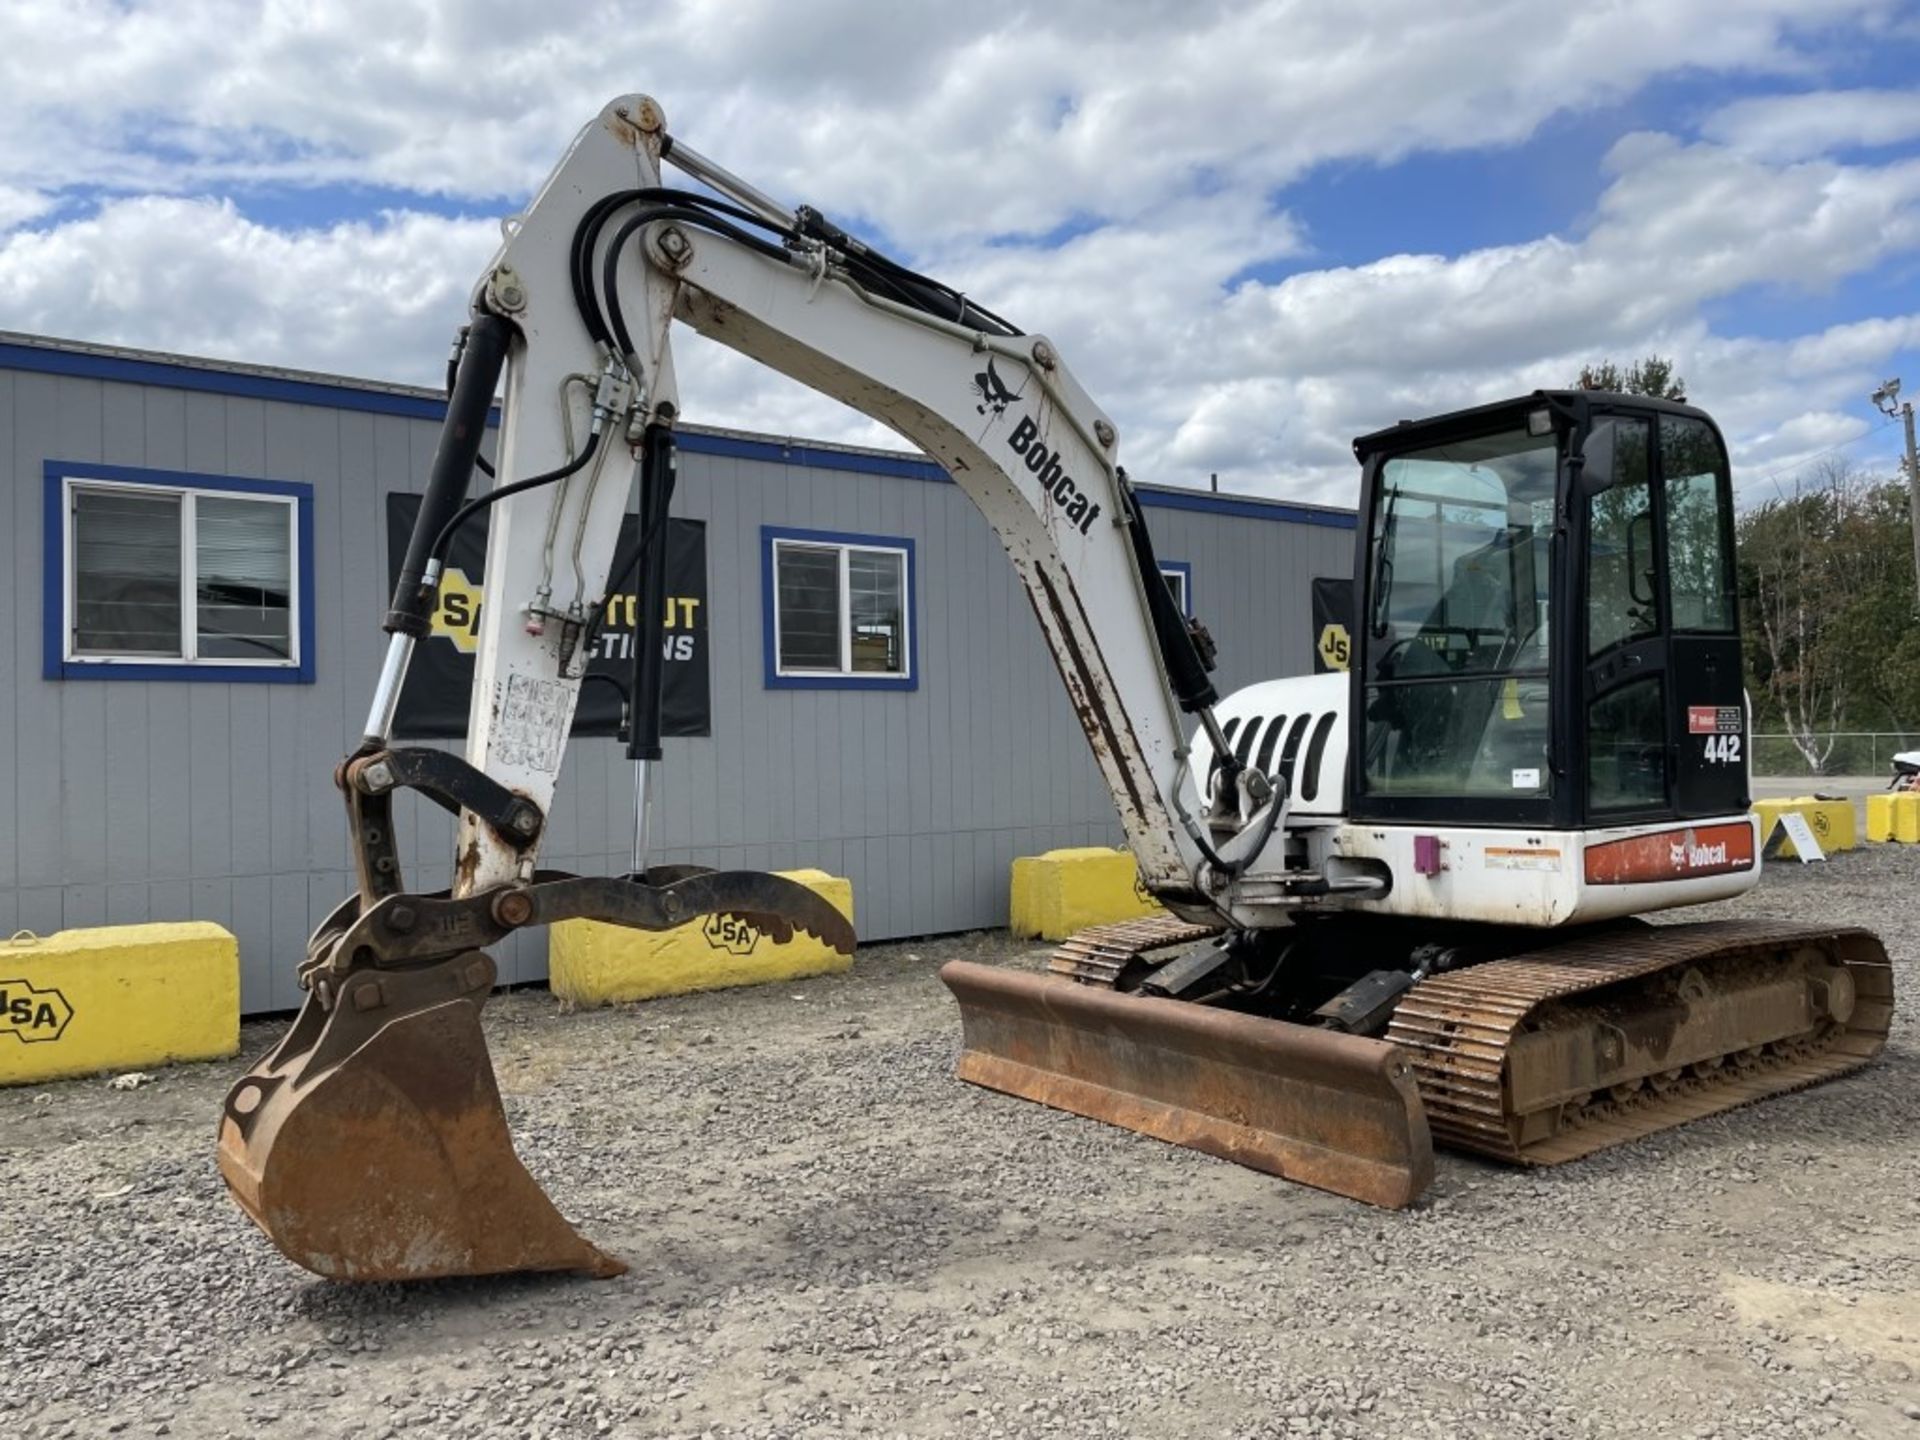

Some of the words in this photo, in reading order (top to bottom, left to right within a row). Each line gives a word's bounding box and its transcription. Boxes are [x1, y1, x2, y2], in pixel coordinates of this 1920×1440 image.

[1008, 414, 1101, 536] Bobcat
[1324, 631, 1350, 669] JS
[1704, 734, 1741, 764] 442
[1689, 842, 1726, 868] Bobcat
[709, 913, 751, 946] JSA
